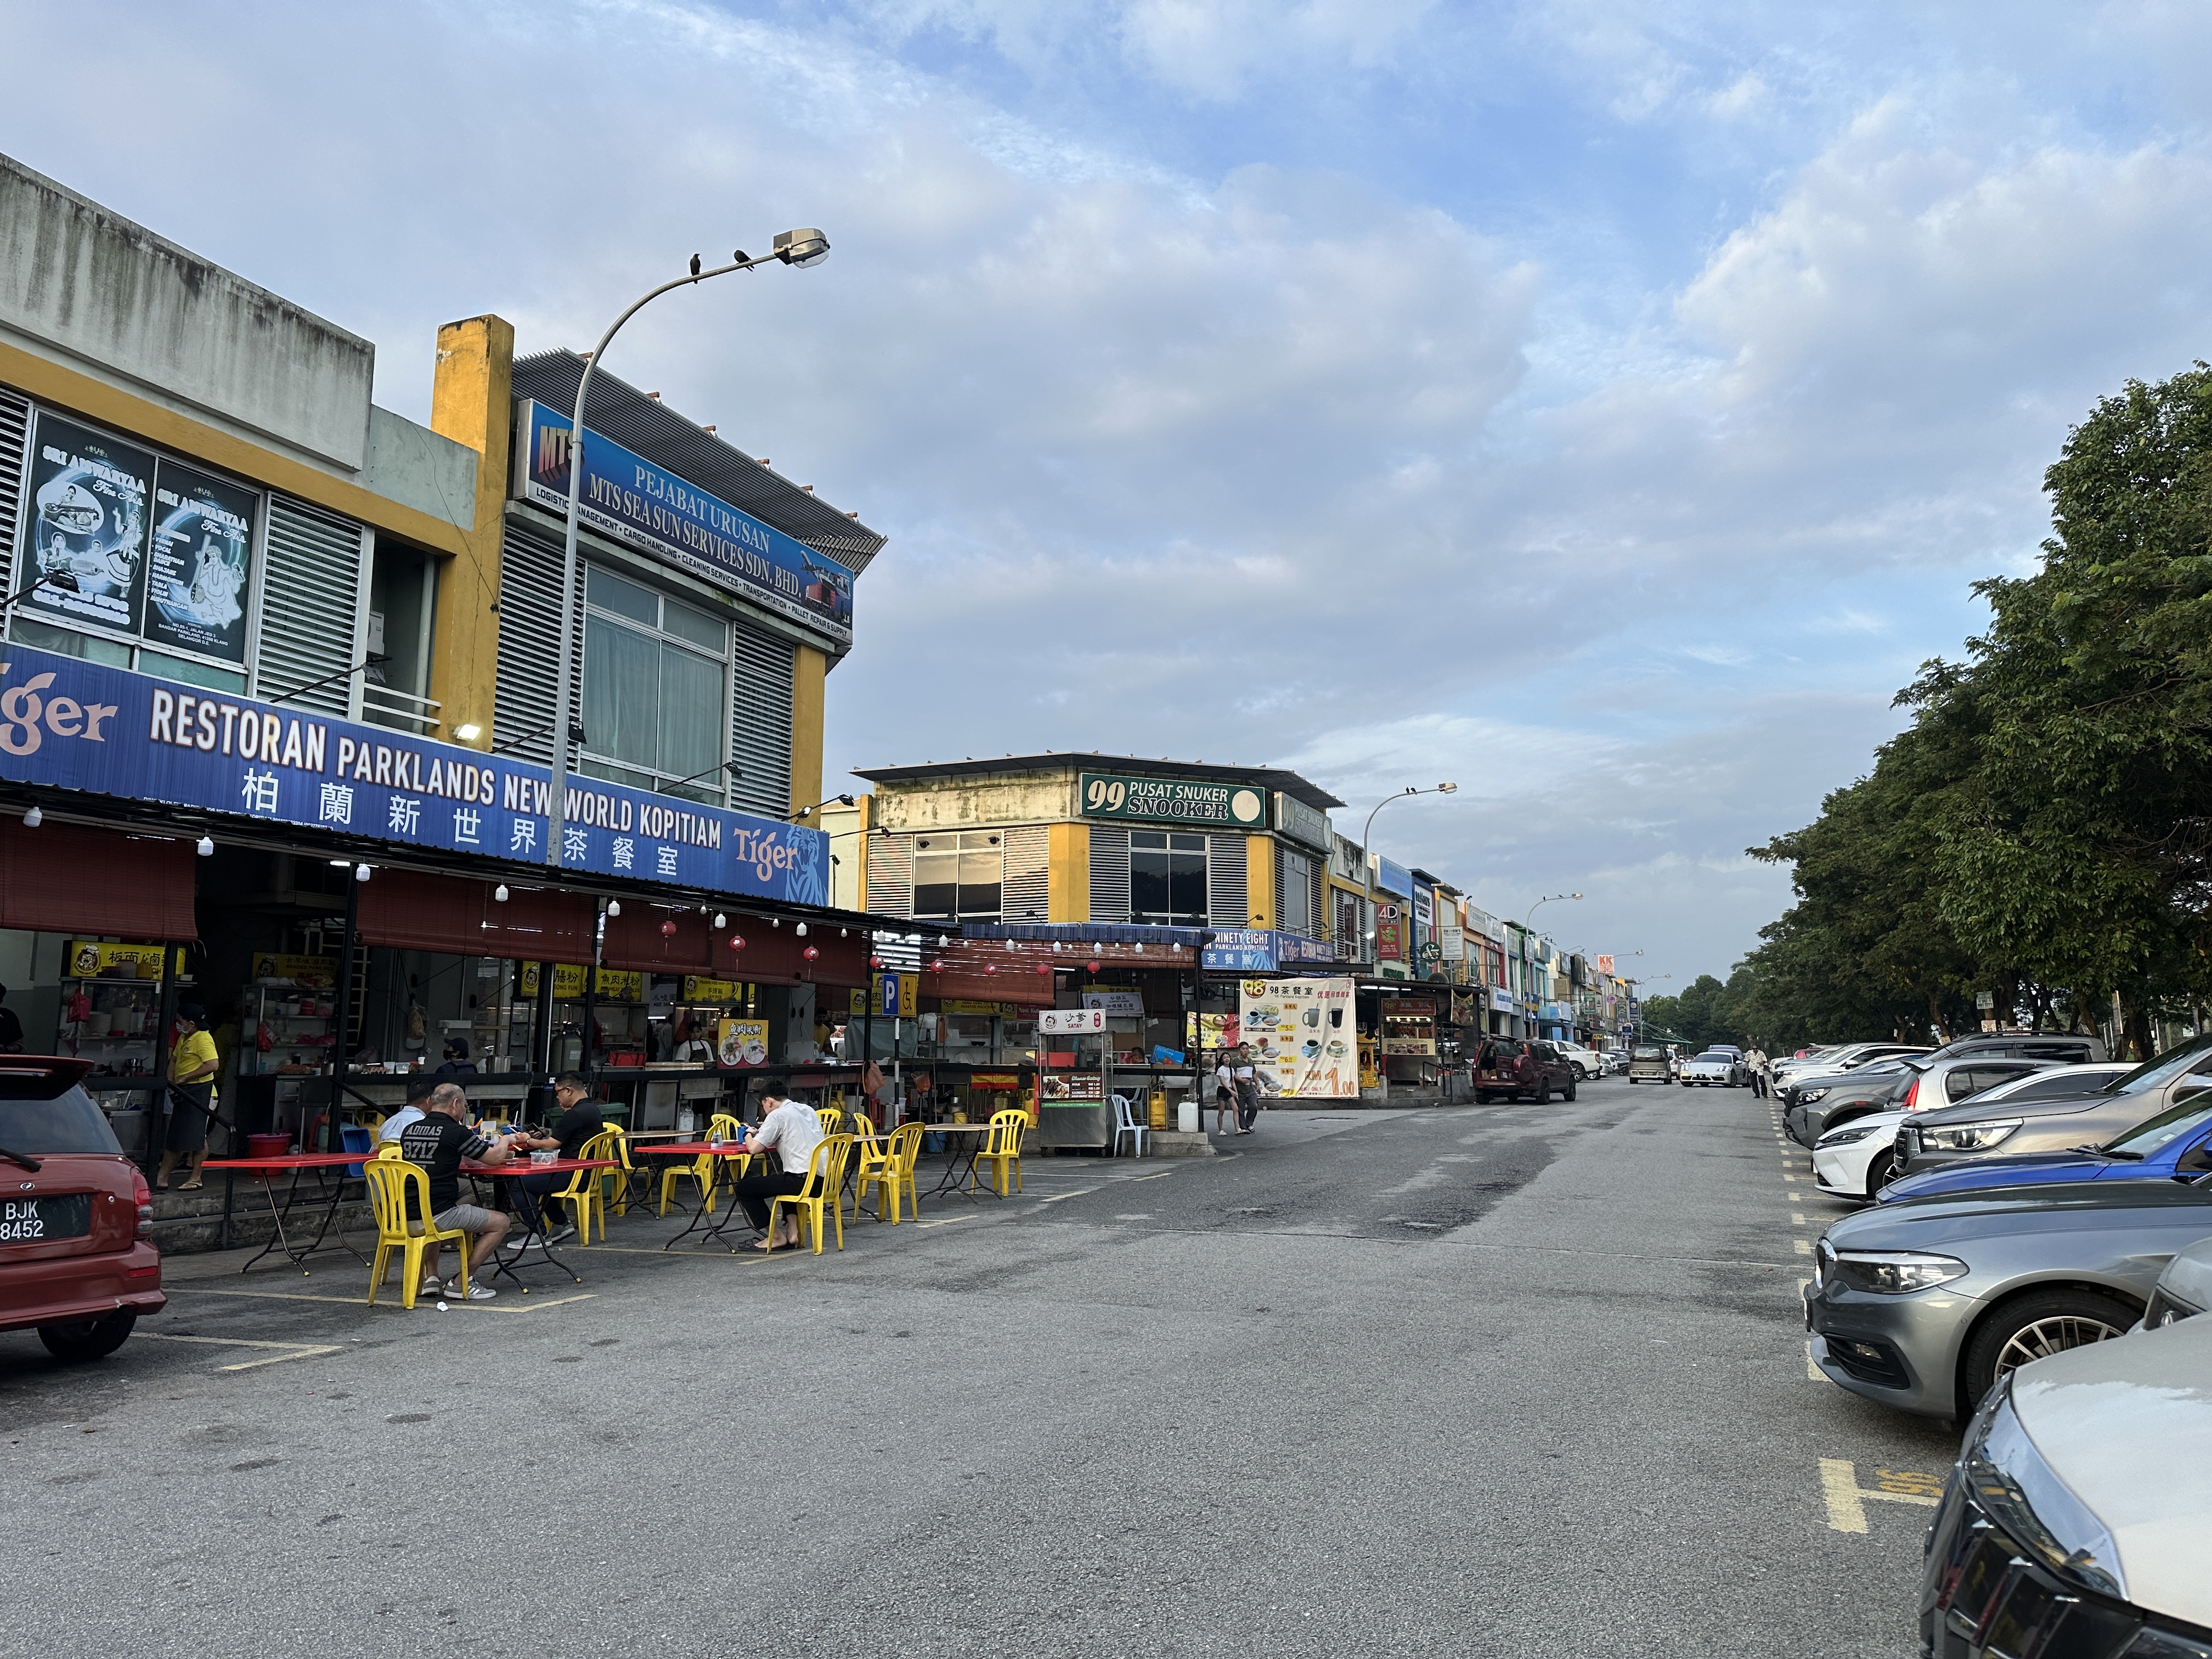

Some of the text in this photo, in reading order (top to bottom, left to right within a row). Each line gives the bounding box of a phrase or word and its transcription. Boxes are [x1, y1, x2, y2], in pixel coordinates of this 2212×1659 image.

[93, 479, 144, 506] Fine Arts
[635, 465, 770, 554] PEJABAT URUSAN
[201, 519, 247, 544] Fine Arts
[589, 472, 620, 511] MTS
[623, 492, 651, 526] SEA
[653, 506, 681, 541] SUN
[683, 522, 744, 572] SERVICES
[746, 552, 773, 585] SDN.
[775, 566, 802, 598] BHD.
[155, 544, 171, 554] VOCAL
[578, 506, 618, 532] ANAGEMENT
[624, 527, 646, 544] CARGO
[647, 536, 677, 559] HANDLING
[682, 555, 710, 575] CLEANING
[711, 567, 739, 588] SERVICES
[743, 582, 787, 610] TRANSPORTATION
[792, 605, 809, 621] PALLET
[810, 614, 827, 629] REPAIR
[831, 624, 848, 638] SUPPLY
[152, 580, 167, 590] TABLA
[158, 623, 177, 633] BANDAR
[178, 633, 201, 644] SELANGOR
[0, 663, 117, 755] ger
[150, 687, 723, 851] RESTORAN PARKLANDS NEW WORLD KOPITIAM
[1087, 780, 1229, 812] 99 PUSAT SNUKER
[1127, 796, 1229, 820] SNOOKER
[1284, 800, 1323, 830] 99 PUSAT SNUKER
[241, 768, 679, 877] 柏蘭新世界茶餐室
[1295, 817, 1324, 845] SNOOKER
[733, 827, 799, 882] Tiger
[1379, 905, 1397, 919] 4D
[1215, 932, 1269, 945] NINETY EIGHT
[1284, 940, 1300, 958] Tiger
[1301, 940, 1317, 959] RESTORAN
[1317, 943, 1325, 955] NINETY
[1600, 956, 1612, 964] KK
[555, 969, 578, 984] 腸粉
[601, 974, 640, 986] 魚肉米粉
[885, 980, 895, 1009] P
[1243, 980, 1267, 994] 98
[1269, 986, 1313, 996] 98 茶餐室
[1305, 1068, 1355, 1096] RM 1.00
[405, 1125, 443, 1136] ADIDAS
[403, 1141, 439, 1159] 9717
[5, 1200, 38, 1220] BJK
[0, 1220, 43, 1240] 8452
